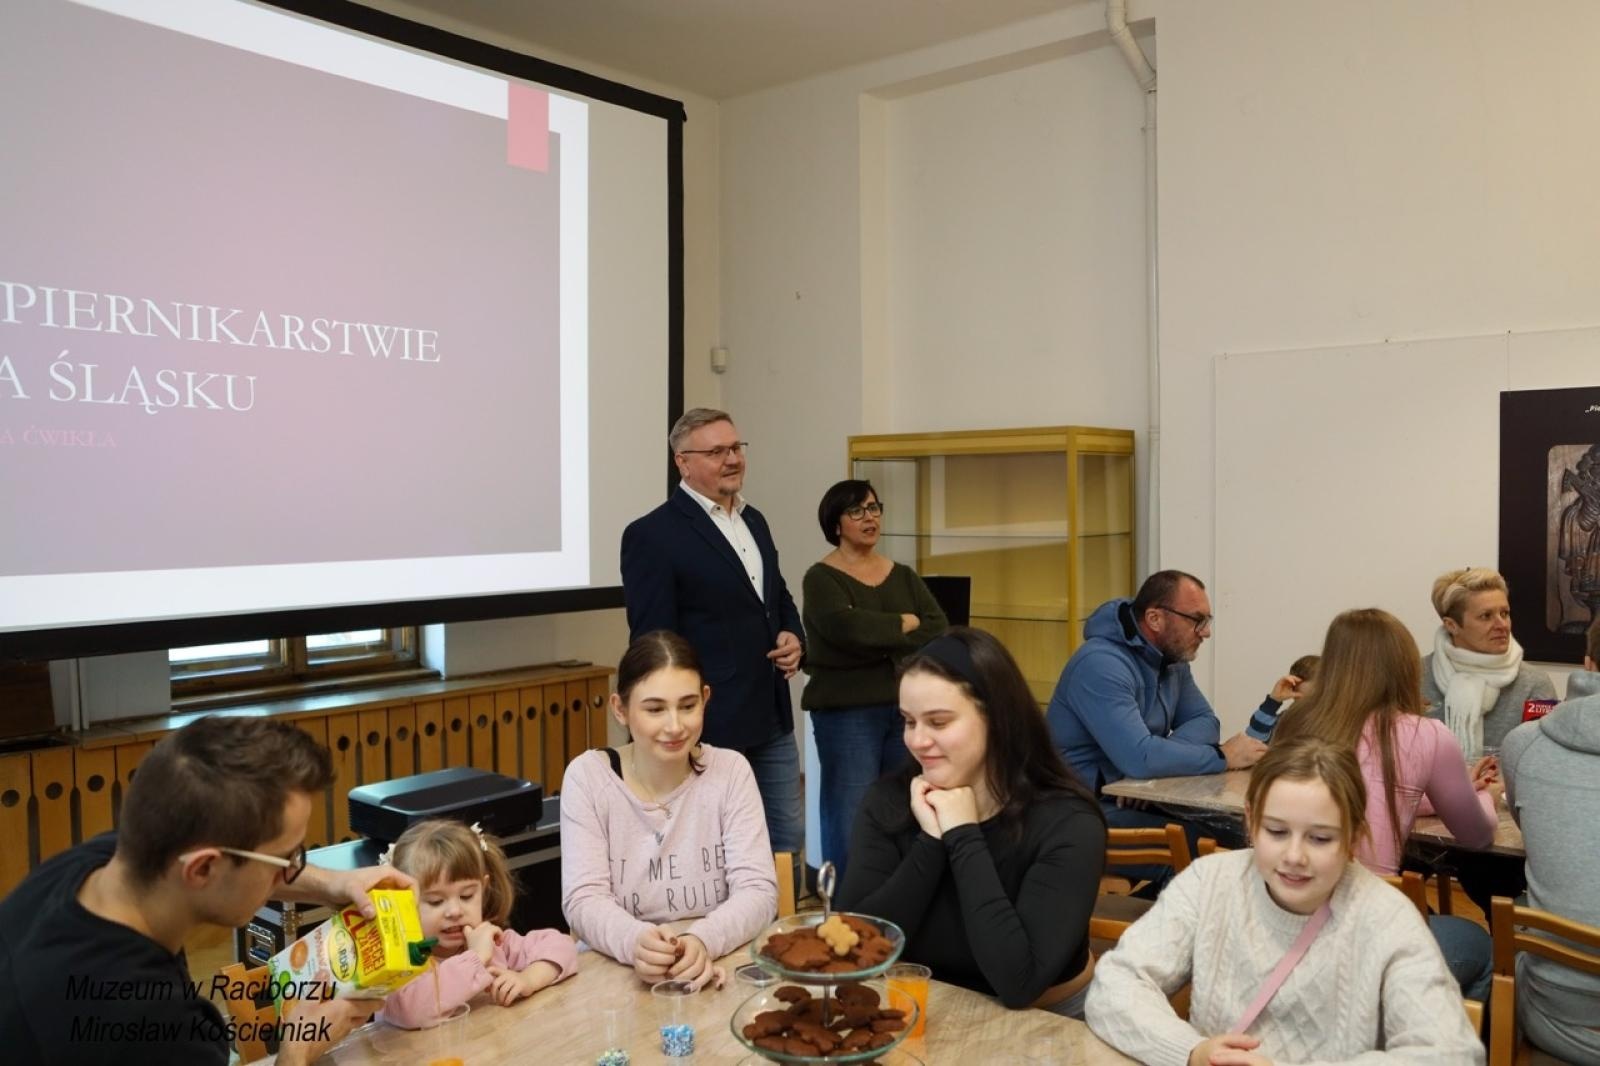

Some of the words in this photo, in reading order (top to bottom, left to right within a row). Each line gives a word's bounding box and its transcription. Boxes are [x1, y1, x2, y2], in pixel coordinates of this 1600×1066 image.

[0, 281, 441, 363] PIERNIKARSTWIE
[49, 349, 257, 415] ŚLĄSKU
[649, 855, 682, 882] ME
[702, 845, 726, 872] BE
[334, 929, 351, 979] GARDEN
